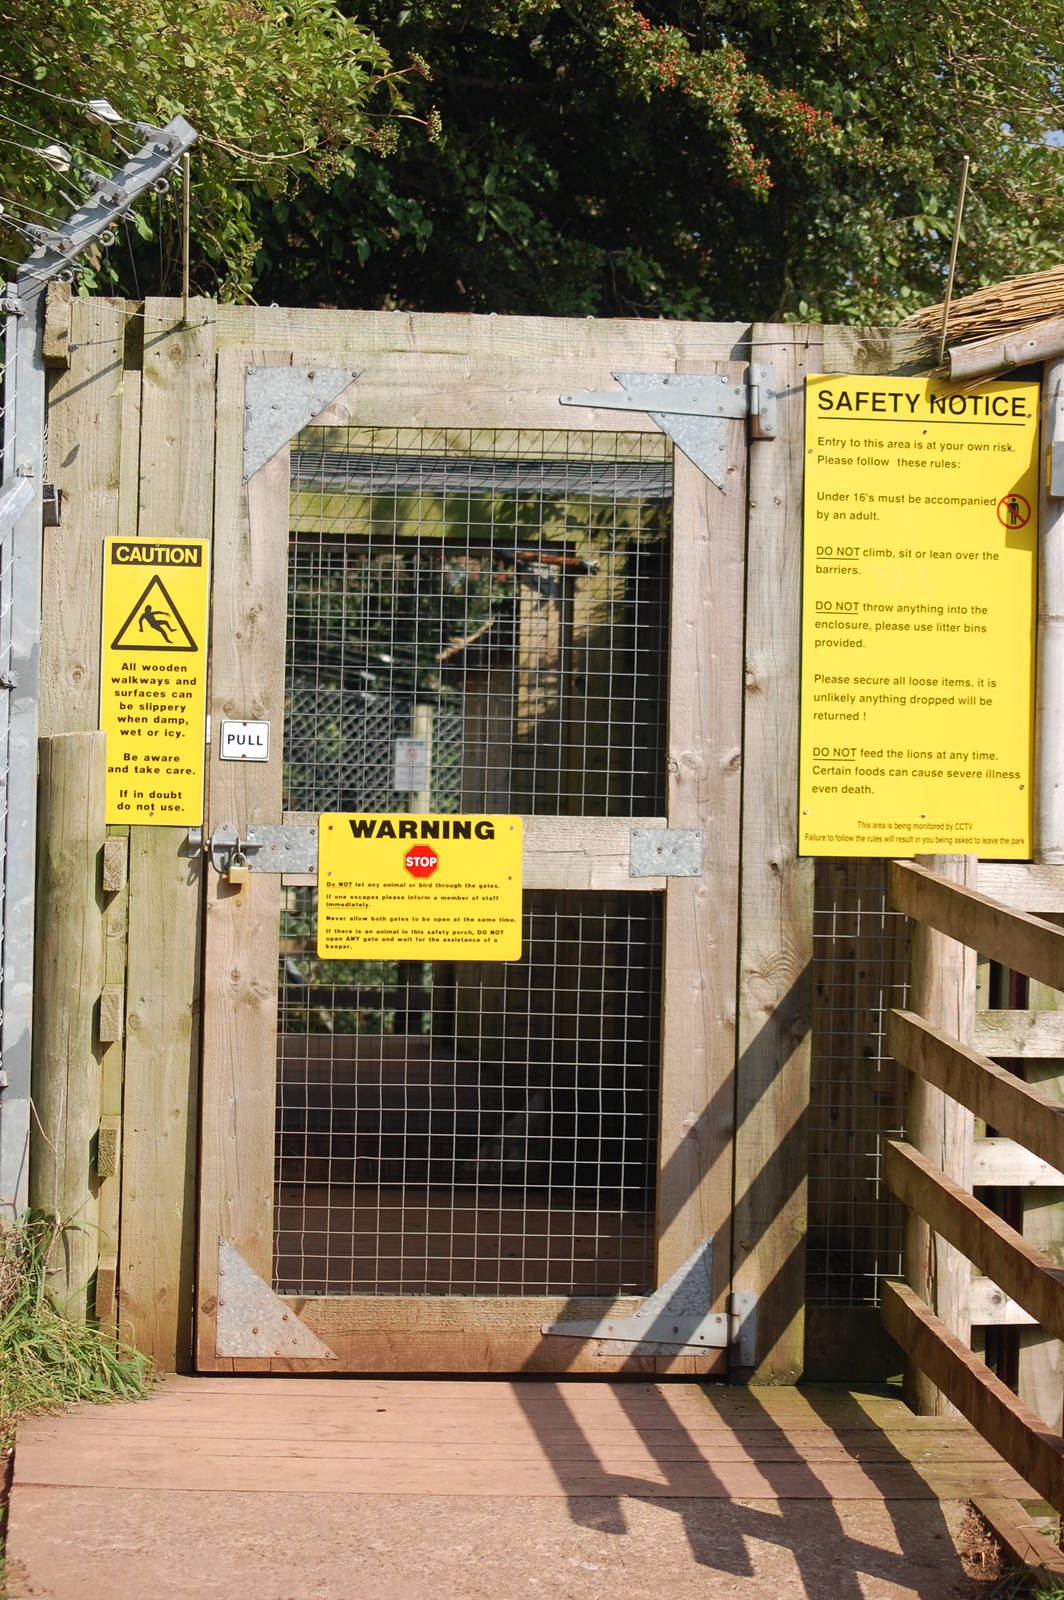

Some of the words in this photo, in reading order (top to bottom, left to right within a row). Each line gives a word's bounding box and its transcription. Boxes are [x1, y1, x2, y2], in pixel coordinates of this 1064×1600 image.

[818, 390, 920, 413] SAFETY
[931, 393, 1026, 417] NOTICE
[818, 437, 846, 449] Entry
[850, 439, 861, 447] to
[864, 439, 884, 448] this
[914, 440, 923, 450] is
[926, 441, 936, 450] at
[940, 443, 964, 452] your
[993, 443, 1015, 452] risk.
[818, 455, 853, 465] Please
[857, 456, 890, 466] follow
[897, 458, 927, 468] these
[930, 460, 960, 468] rules:
[817, 492, 850, 501] Under
[854, 493, 874, 502] 16's
[878, 495, 905, 503] must
[908, 495, 921, 504] be
[924, 497, 996, 507] accompanied
[817, 510, 829, 521] by
[850, 512, 879, 520] adult.
[116, 546, 197, 563] CAUTION
[817, 546, 833, 556] DO
[837, 547, 860, 556] NOT
[863, 548, 895, 558] climb,
[899, 549, 912, 558] sit
[930, 550, 952, 559] lean
[982, 552, 999, 561] the
[816, 565, 861, 575] barriers.
[816, 601, 833, 613] DO
[835, 602, 860, 613] NOT
[863, 603, 894, 612] throw
[897, 604, 944, 616] anything
[948, 605, 968, 614] into
[971, 606, 988, 615] the
[815, 620, 872, 630] enclosure,
[875, 621, 910, 632] please
[937, 623, 961, 632] litter
[964, 624, 987, 633] bins
[815, 638, 865, 648] provided.
[121, 663, 136, 671] All
[142, 664, 187, 672] wooden
[112, 676, 170, 686] walkways
[176, 677, 196, 685] and
[814, 674, 850, 684] Please
[893, 676, 905, 685] all
[909, 677, 938, 686] loose
[942, 678, 974, 688] items,
[978, 679, 984, 687] it
[988, 679, 997, 688] is
[115, 689, 166, 698] surfaces
[814, 693, 856, 704] unlikely
[859, 694, 906, 706] anything
[910, 695, 955, 706] dropped
[958, 696, 976, 705] will
[980, 697, 992, 706] be
[120, 702, 133, 710] be
[139, 702, 186, 713] slippery
[117, 715, 148, 723] when
[154, 716, 188, 725] damp,
[814, 712, 859, 721] returned
[165, 729, 185, 739] icy.
[228, 734, 263, 746] PULL
[124, 753, 138, 761] Be
[813, 747, 830, 757] DO
[833, 748, 857, 757] NOT
[860, 748, 883, 758] feed
[887, 749, 904, 758] the
[907, 749, 933, 759] lions
[936, 751, 946, 759] at
[949, 752, 969, 762] any
[972, 752, 998, 760] time.
[108, 765, 128, 773] and
[134, 766, 160, 774] take
[812, 765, 851, 775] Certain
[855, 766, 886, 776] foods
[986, 770, 1021, 779] illness
[149, 790, 182, 799] doubt
[841, 785, 874, 794] death.
[117, 802, 131, 810] do
[136, 803, 154, 811] not
[349, 820, 494, 840] WARNING
[406, 857, 437, 867] STOP
